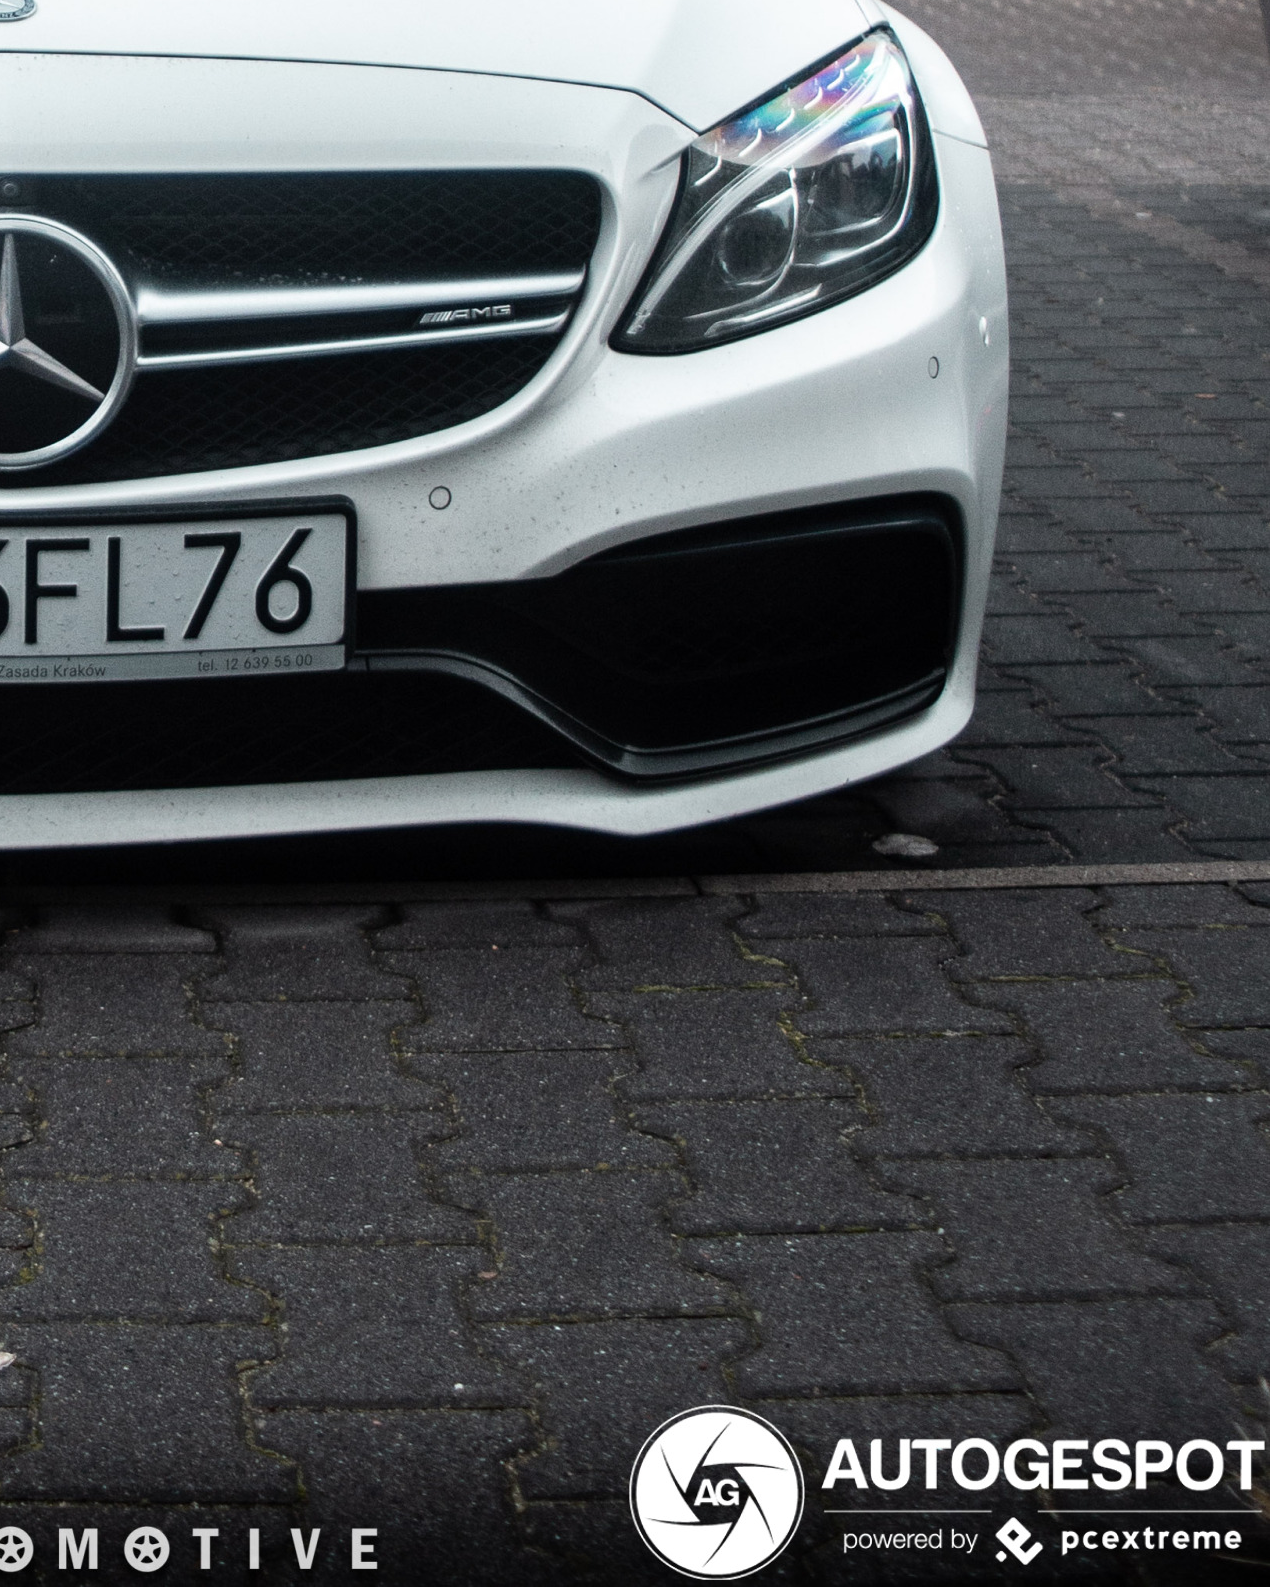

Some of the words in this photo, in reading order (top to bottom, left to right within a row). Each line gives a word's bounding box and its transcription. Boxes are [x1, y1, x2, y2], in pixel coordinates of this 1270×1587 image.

[449, 304, 512, 320] AMG
[53, 663, 107, 678] Kraków
[197, 658, 219, 673] tel.
[225, 657, 239, 671] 12
[243, 656, 270, 670] 639
[274, 656, 292, 670] 55
[295, 655, 314, 669] 00
